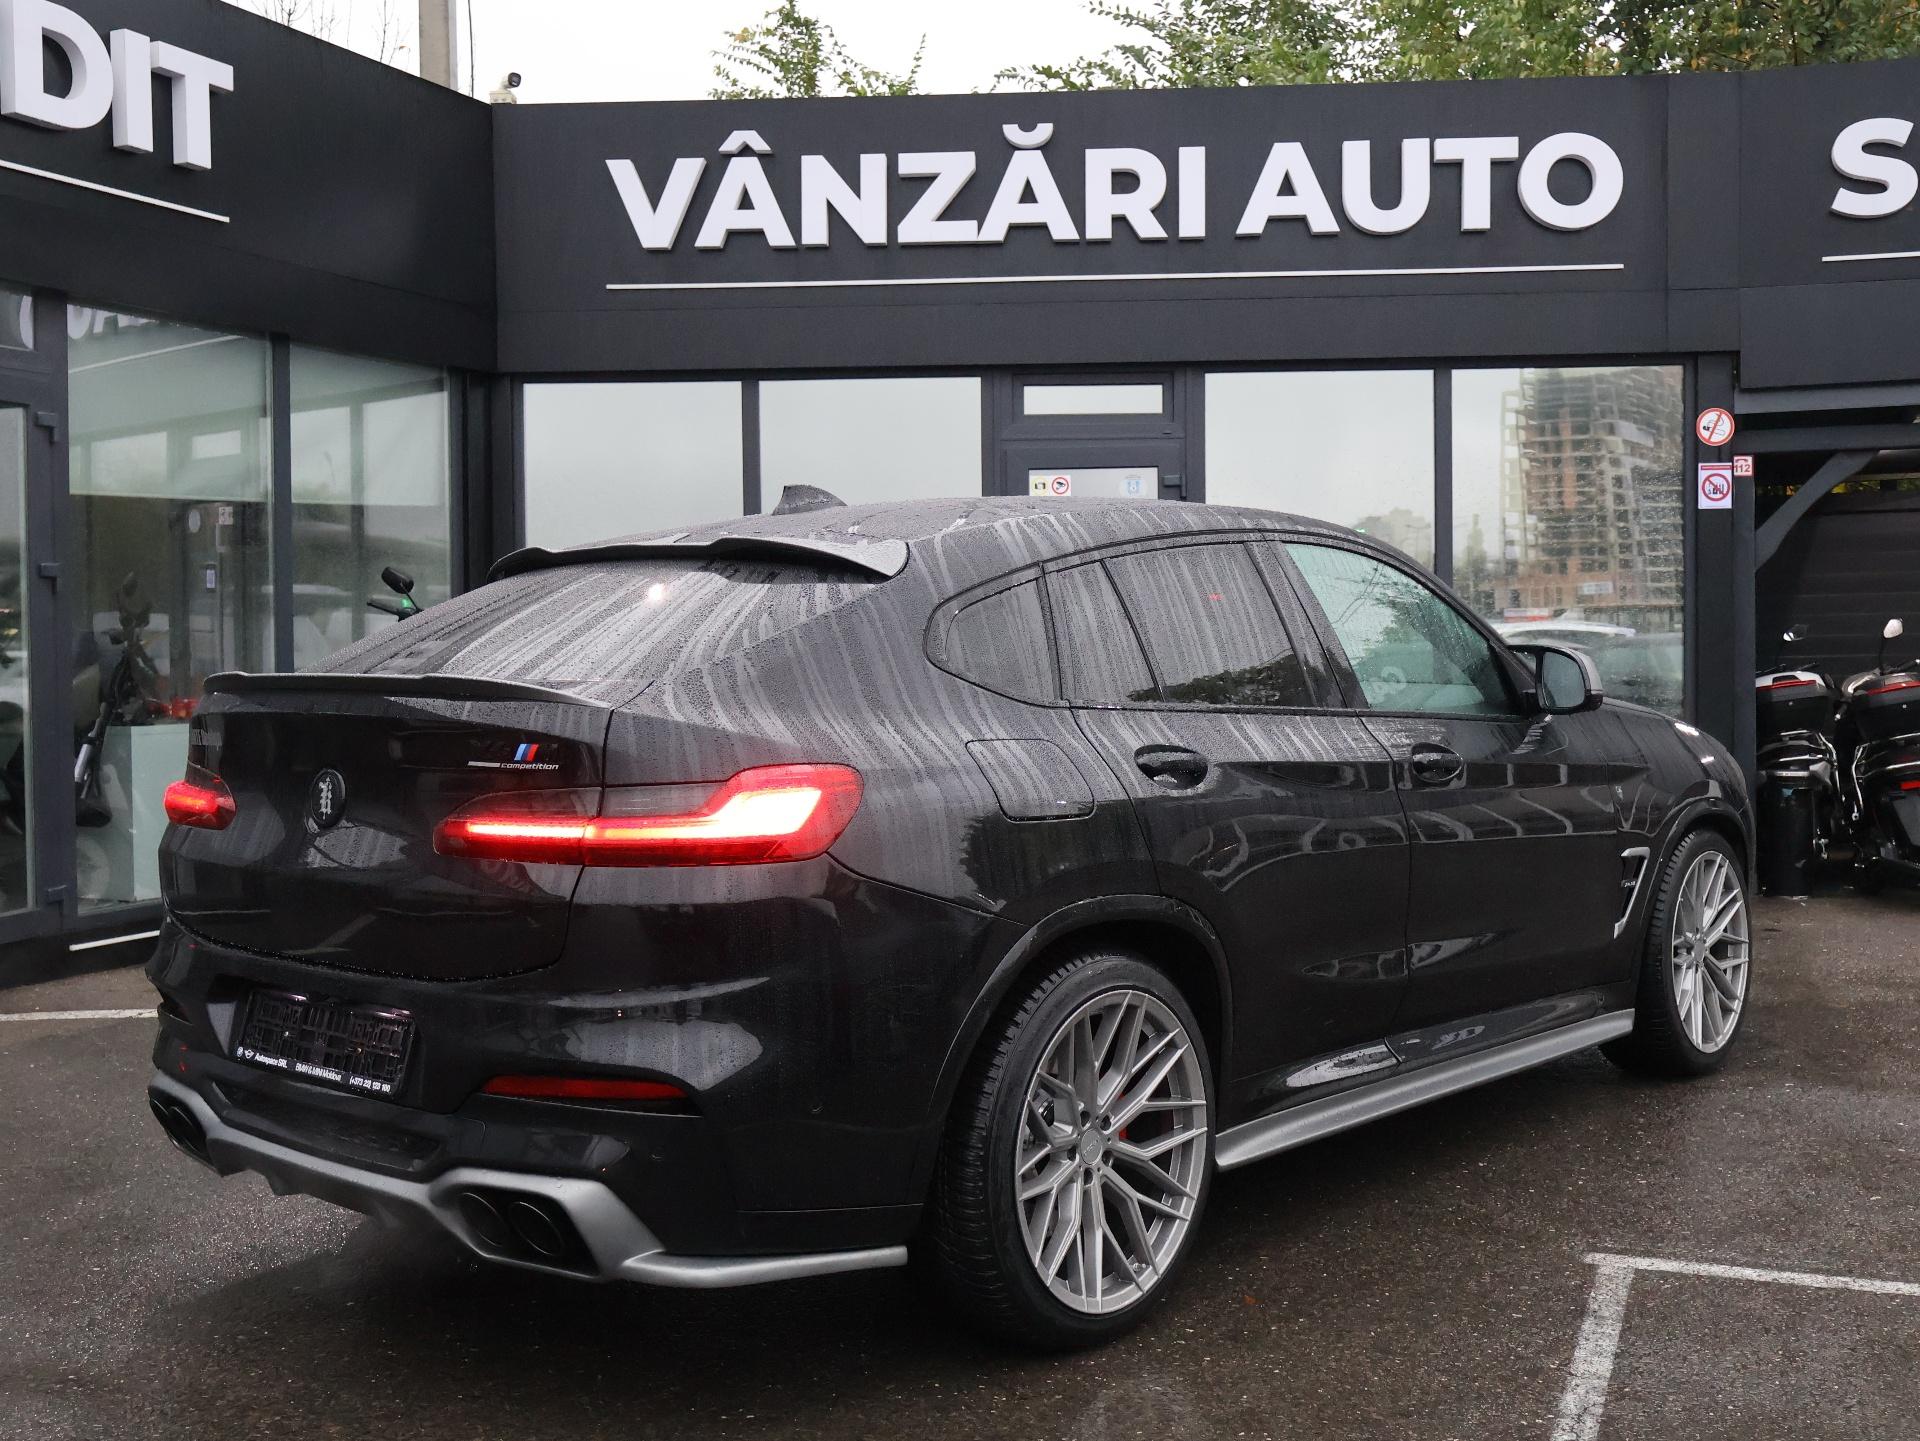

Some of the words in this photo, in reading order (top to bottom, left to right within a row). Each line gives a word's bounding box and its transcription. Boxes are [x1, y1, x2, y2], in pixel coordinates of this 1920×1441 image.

[605, 122, 1206, 250] VÂNZĂRI
[1235, 132, 1624, 236] AUTO
[1734, 464, 1751, 473] 112
[501, 762, 559, 770] competition
